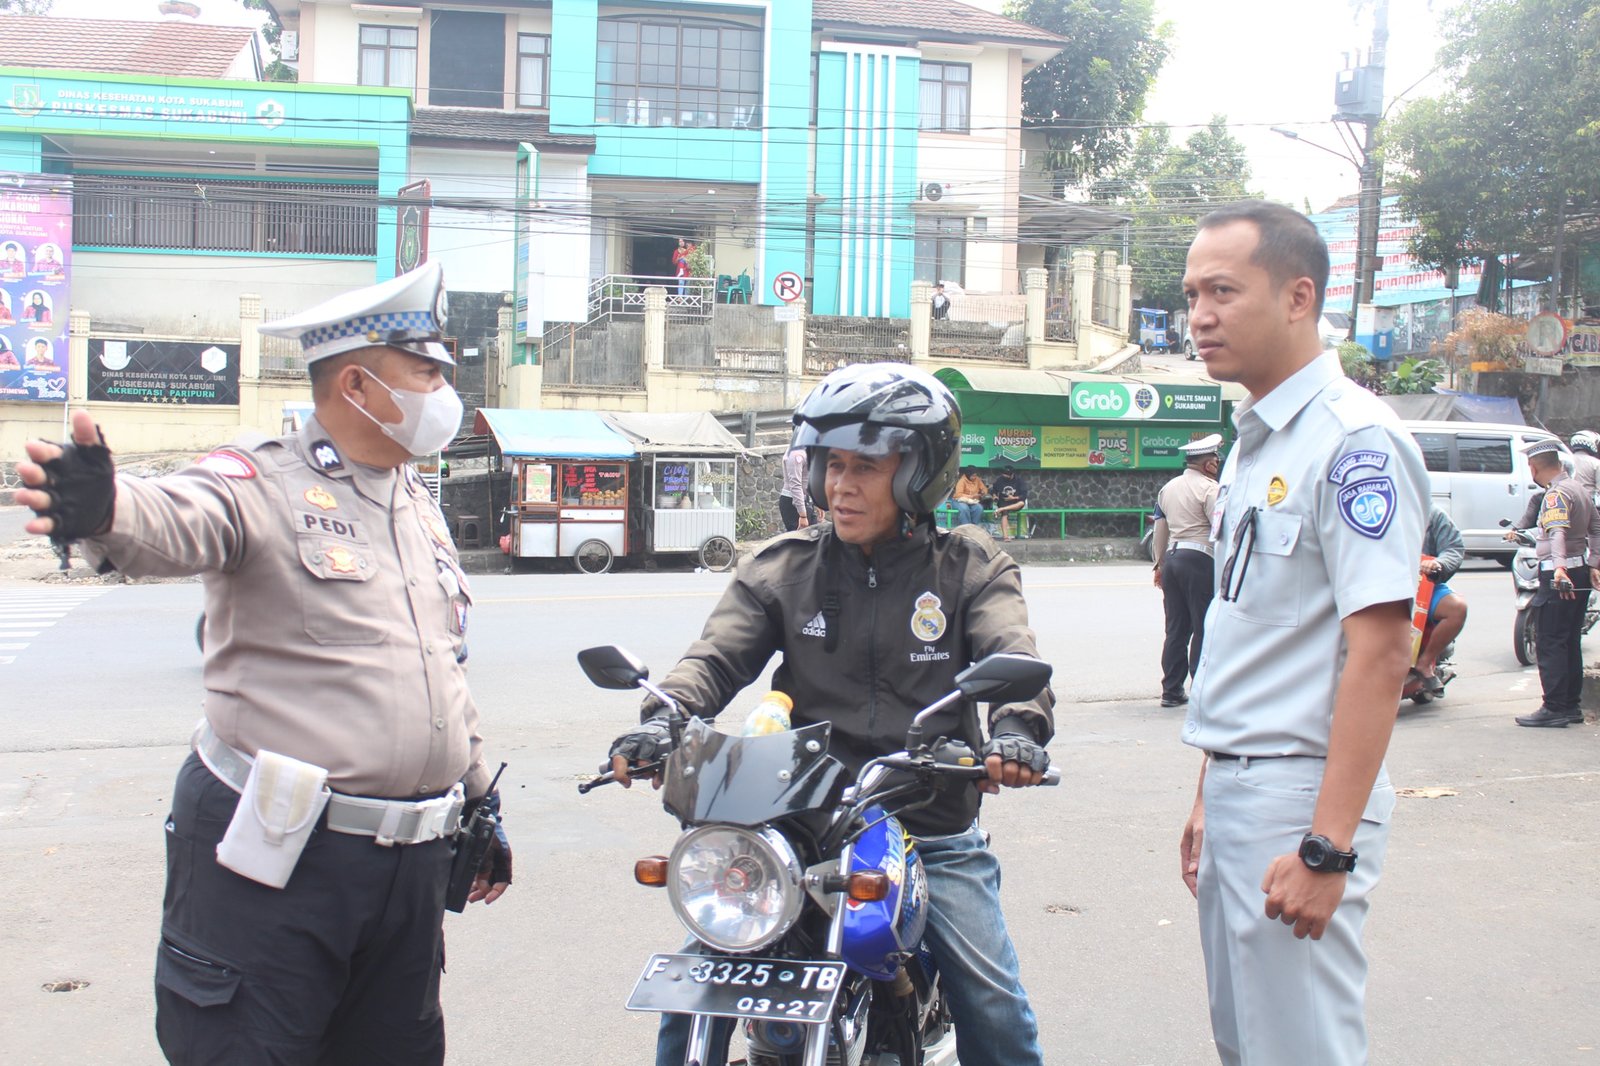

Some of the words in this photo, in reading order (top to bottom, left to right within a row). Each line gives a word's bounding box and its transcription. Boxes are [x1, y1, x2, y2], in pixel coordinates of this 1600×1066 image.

[58, 90, 89, 100] DINAS
[94, 92, 155, 104] KESEHATAN
[159, 96, 185, 105] KOTA
[190, 97, 244, 108] SUKABUMI
[51, 101, 154, 119] PUSKESMAS
[161, 107, 247, 124] SUKABUMI
[780, 277, 796, 297] P
[125, 371, 168, 380] KESEHATAN
[168, 373, 187, 381] KOTA
[113, 379, 166, 389] PUSKESMAS
[170, 382, 215, 390] SUKABUMI
[106, 386, 163, 396] AKREDITASI
[169, 389, 215, 398] PARIPURN
[1174, 394, 1194, 402] HALTE
[1194, 394, 1212, 402] SMAN
[1075, 389, 1123, 411] Grab
[1174, 402, 1206, 410] SUKABUMI
[961, 433, 986, 444] Bike
[998, 428, 1033, 438] MURAH
[1044, 435, 1088, 445] GrabFood
[1098, 438, 1128, 452] PUAS
[1141, 436, 1180, 447] GrabCar
[1334, 456, 1357, 480] CABANG
[1358, 454, 1383, 464] JABAR
[1342, 489, 1358, 503] JASA
[1357, 482, 1389, 494] RAHARJA
[303, 513, 356, 538] PEDI
[802, 626, 826, 638] adida
[924, 645, 935, 653] Fly
[910, 651, 950, 662] Emirates
[883, 811, 903, 886] SUZU
[644, 958, 671, 981] F
[693, 960, 774, 986] 3325
[800, 966, 839, 991] TB
